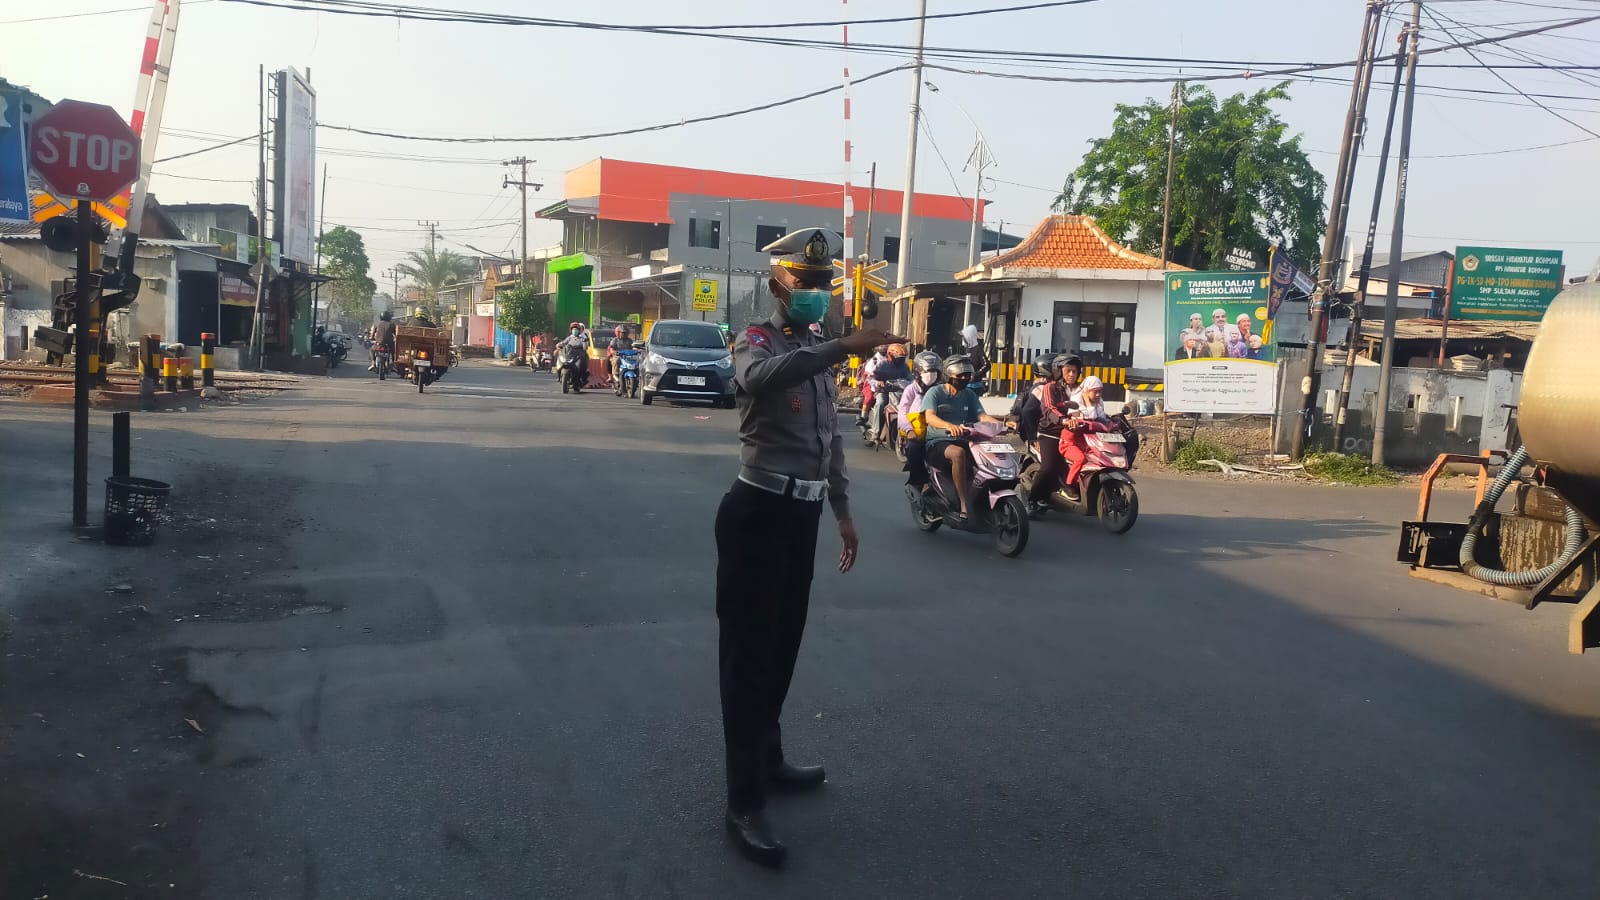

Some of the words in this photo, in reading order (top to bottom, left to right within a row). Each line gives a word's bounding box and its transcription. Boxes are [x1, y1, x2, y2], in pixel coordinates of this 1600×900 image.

[36, 126, 133, 173] STOP
[1232, 247, 1252, 260] KUA
[1188, 280, 1223, 288] TAMBAK
[1189, 287, 1254, 295] BERSHOLAWAT
